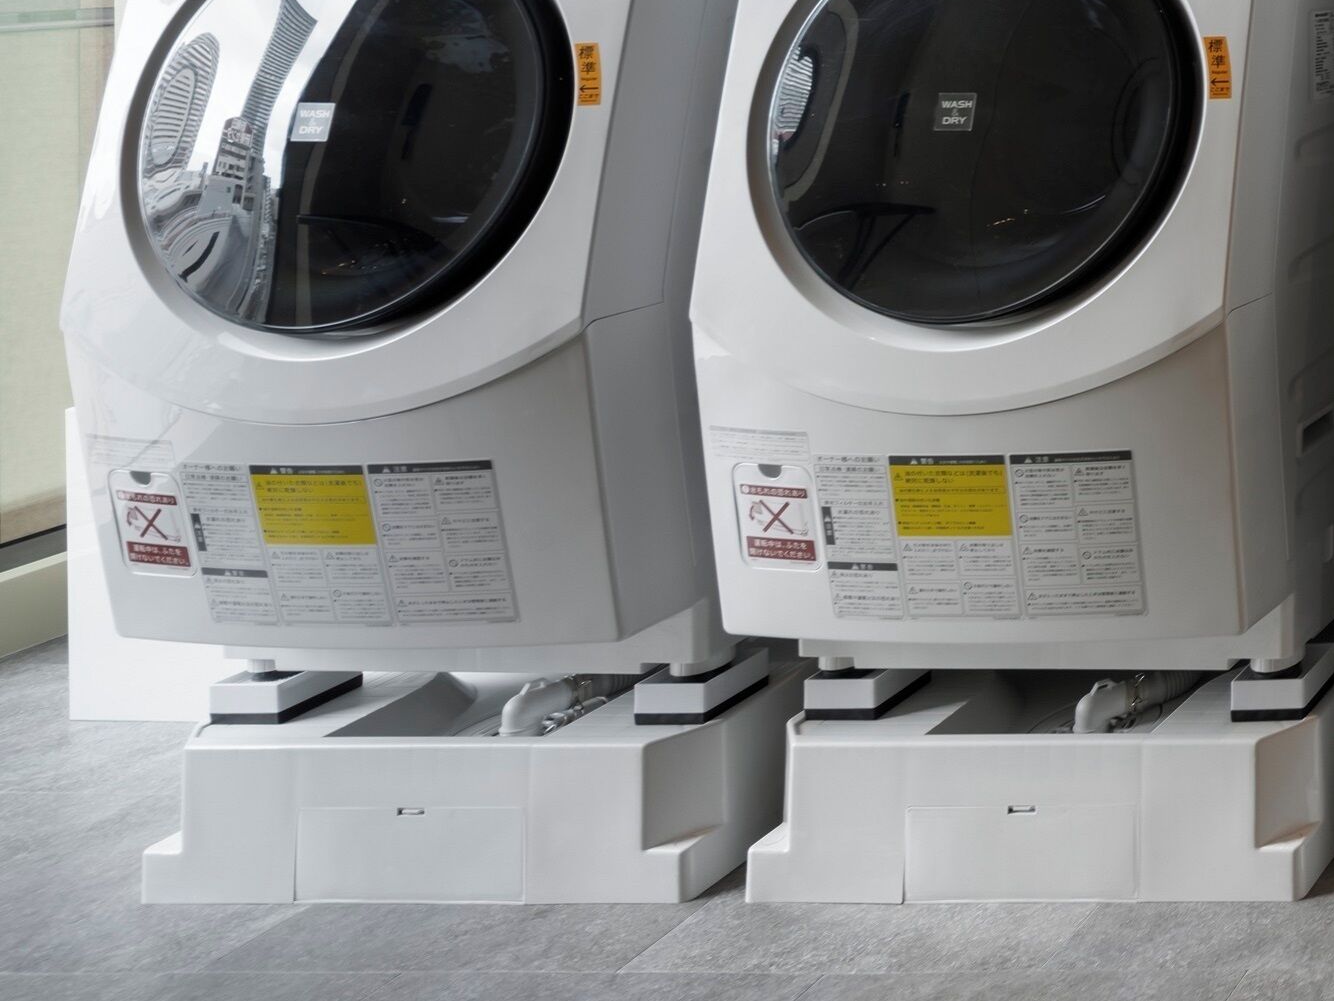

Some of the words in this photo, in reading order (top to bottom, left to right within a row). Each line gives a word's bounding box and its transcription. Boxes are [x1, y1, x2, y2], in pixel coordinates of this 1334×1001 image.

[942, 100, 973, 109] WASH
[300, 110, 330, 118] WASH
[942, 117, 968, 125] DRY
[299, 126, 324, 134] DRY
